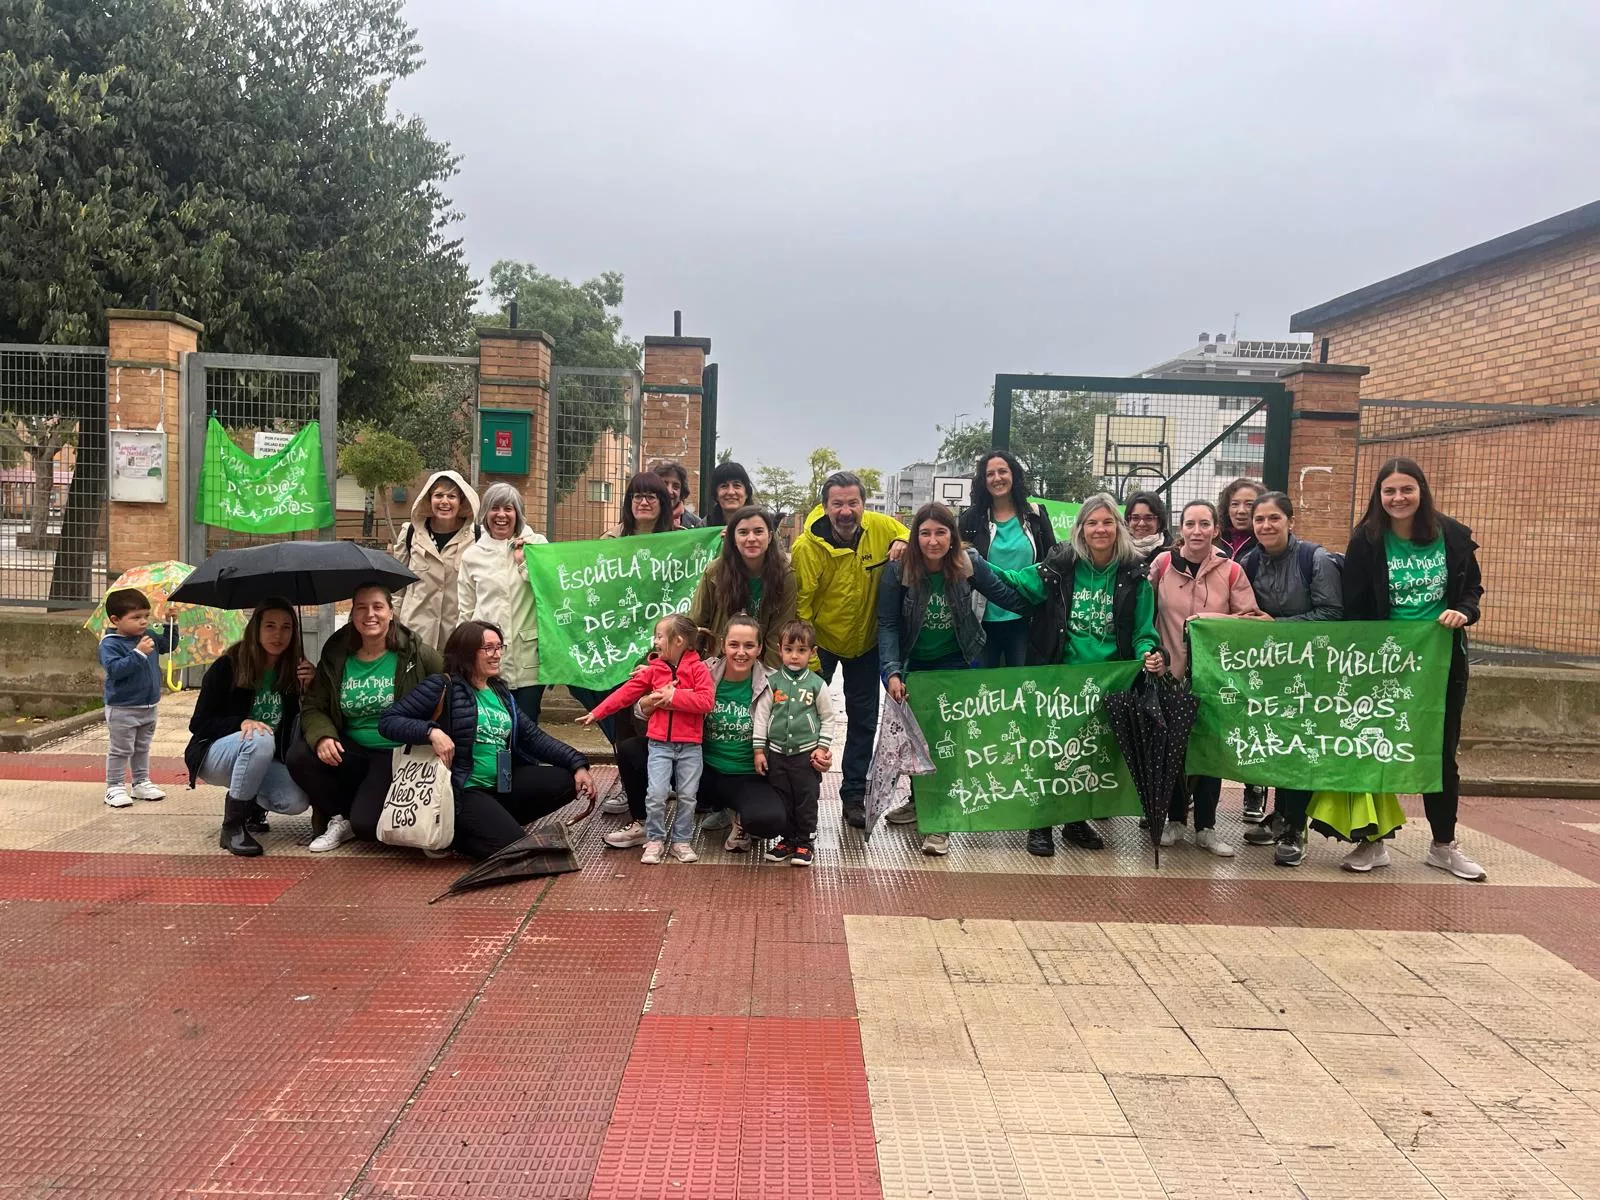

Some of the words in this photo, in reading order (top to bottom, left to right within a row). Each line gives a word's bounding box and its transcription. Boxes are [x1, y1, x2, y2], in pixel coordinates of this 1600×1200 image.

[559, 555, 642, 590] ESCUELA
[1415, 555, 1445, 570] PÚBLIC
[584, 610, 616, 634] DE
[628, 597, 692, 623] TOD@
[1071, 610, 1085, 619] DE
[575, 642, 641, 668] PARA
[1220, 641, 1314, 672] ESCUELA
[1327, 643, 1422, 676] PÚBLICA:
[360, 694, 394, 705] TOD@
[798, 688, 814, 705] 75
[940, 687, 1026, 722] ESCUELA
[1035, 687, 1100, 719] PÚBLIC
[1247, 696, 1278, 717] DE
[1293, 695, 1395, 720] TOD@S
[965, 744, 998, 768] DE
[1010, 736, 1098, 761] TOD@S
[1234, 734, 1307, 759] PARA
[1315, 735, 1415, 763] TOD@S
[1237, 756, 1266, 767] Huesca
[417, 785, 433, 806] is
[959, 782, 1029, 808] PARA
[1033, 772, 1119, 796] TOD@S
[962, 804, 989, 815] Huesca
